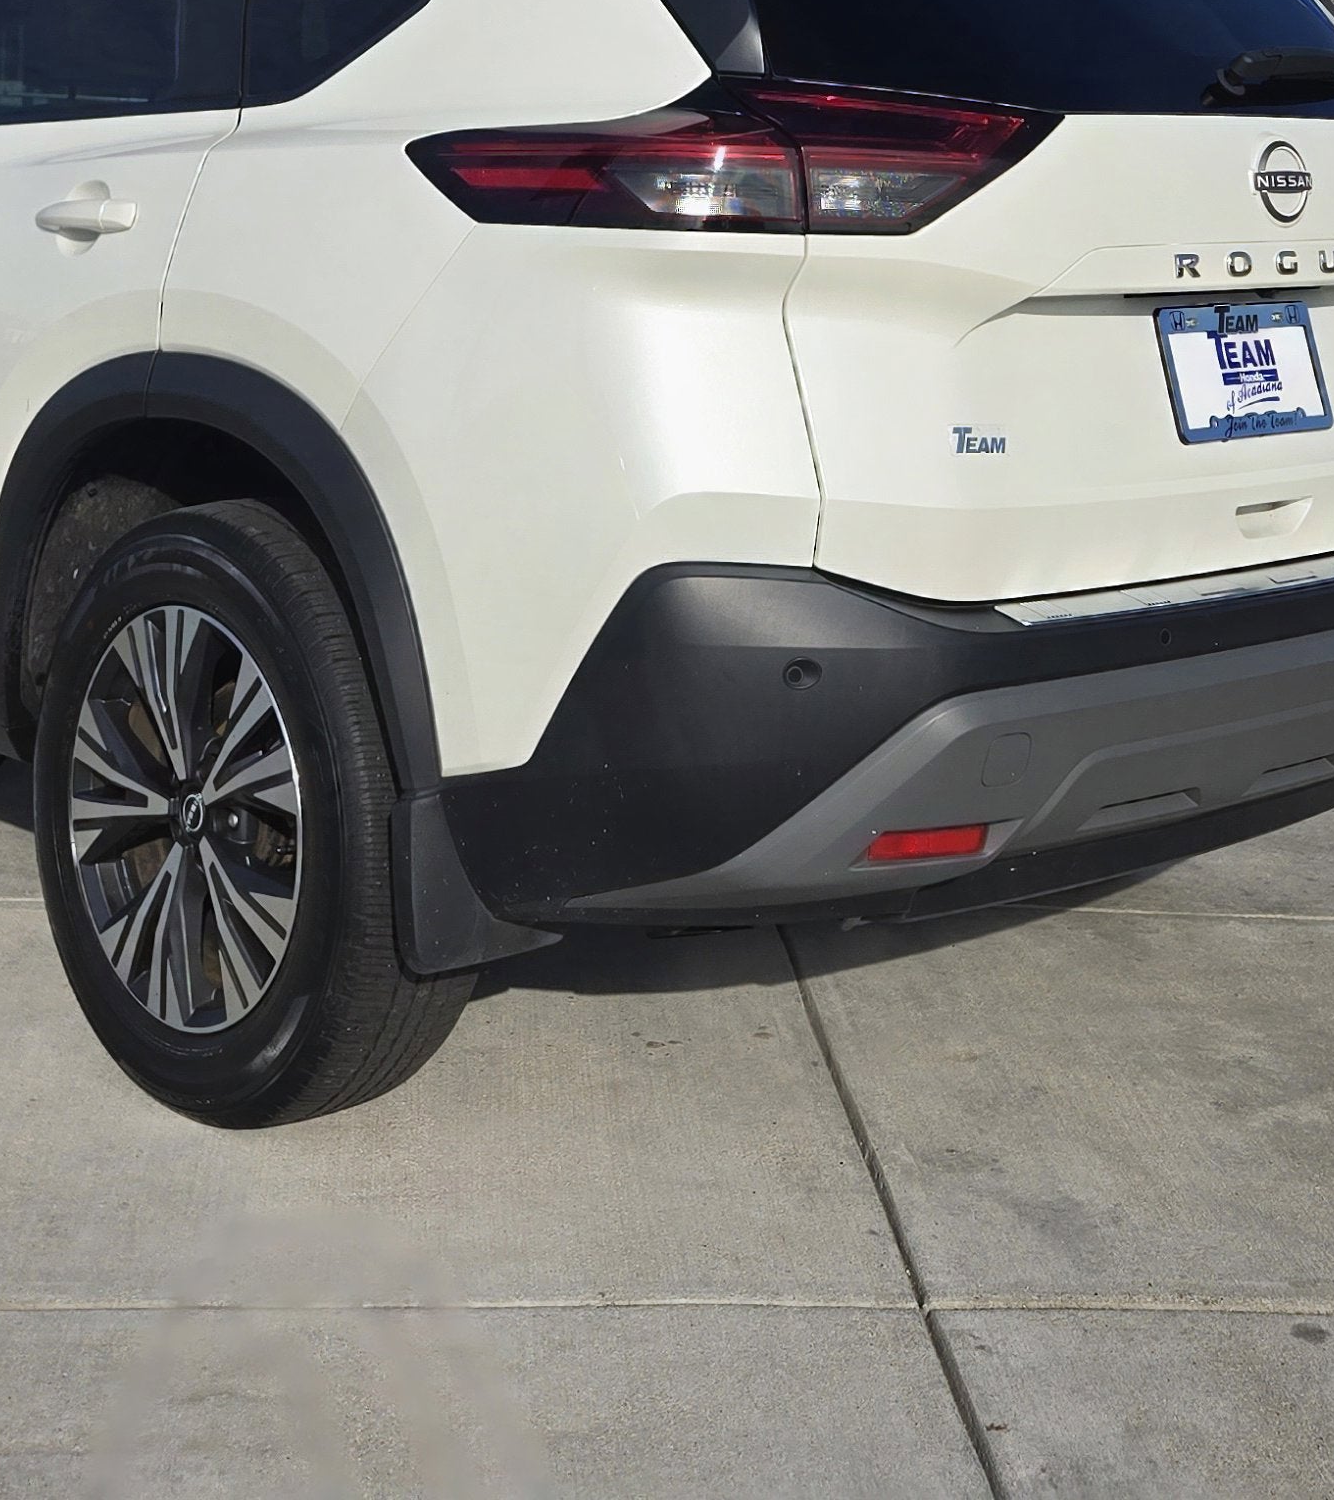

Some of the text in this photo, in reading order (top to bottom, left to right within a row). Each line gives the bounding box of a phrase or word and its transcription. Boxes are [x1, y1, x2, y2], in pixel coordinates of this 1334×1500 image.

[1257, 174, 1313, 190] NISSAN
[1214, 305, 1259, 334] TEAM
[1207, 331, 1276, 370] TEAM
[1239, 371, 1265, 382] Honda
[952, 426, 1006, 453] TEAM
